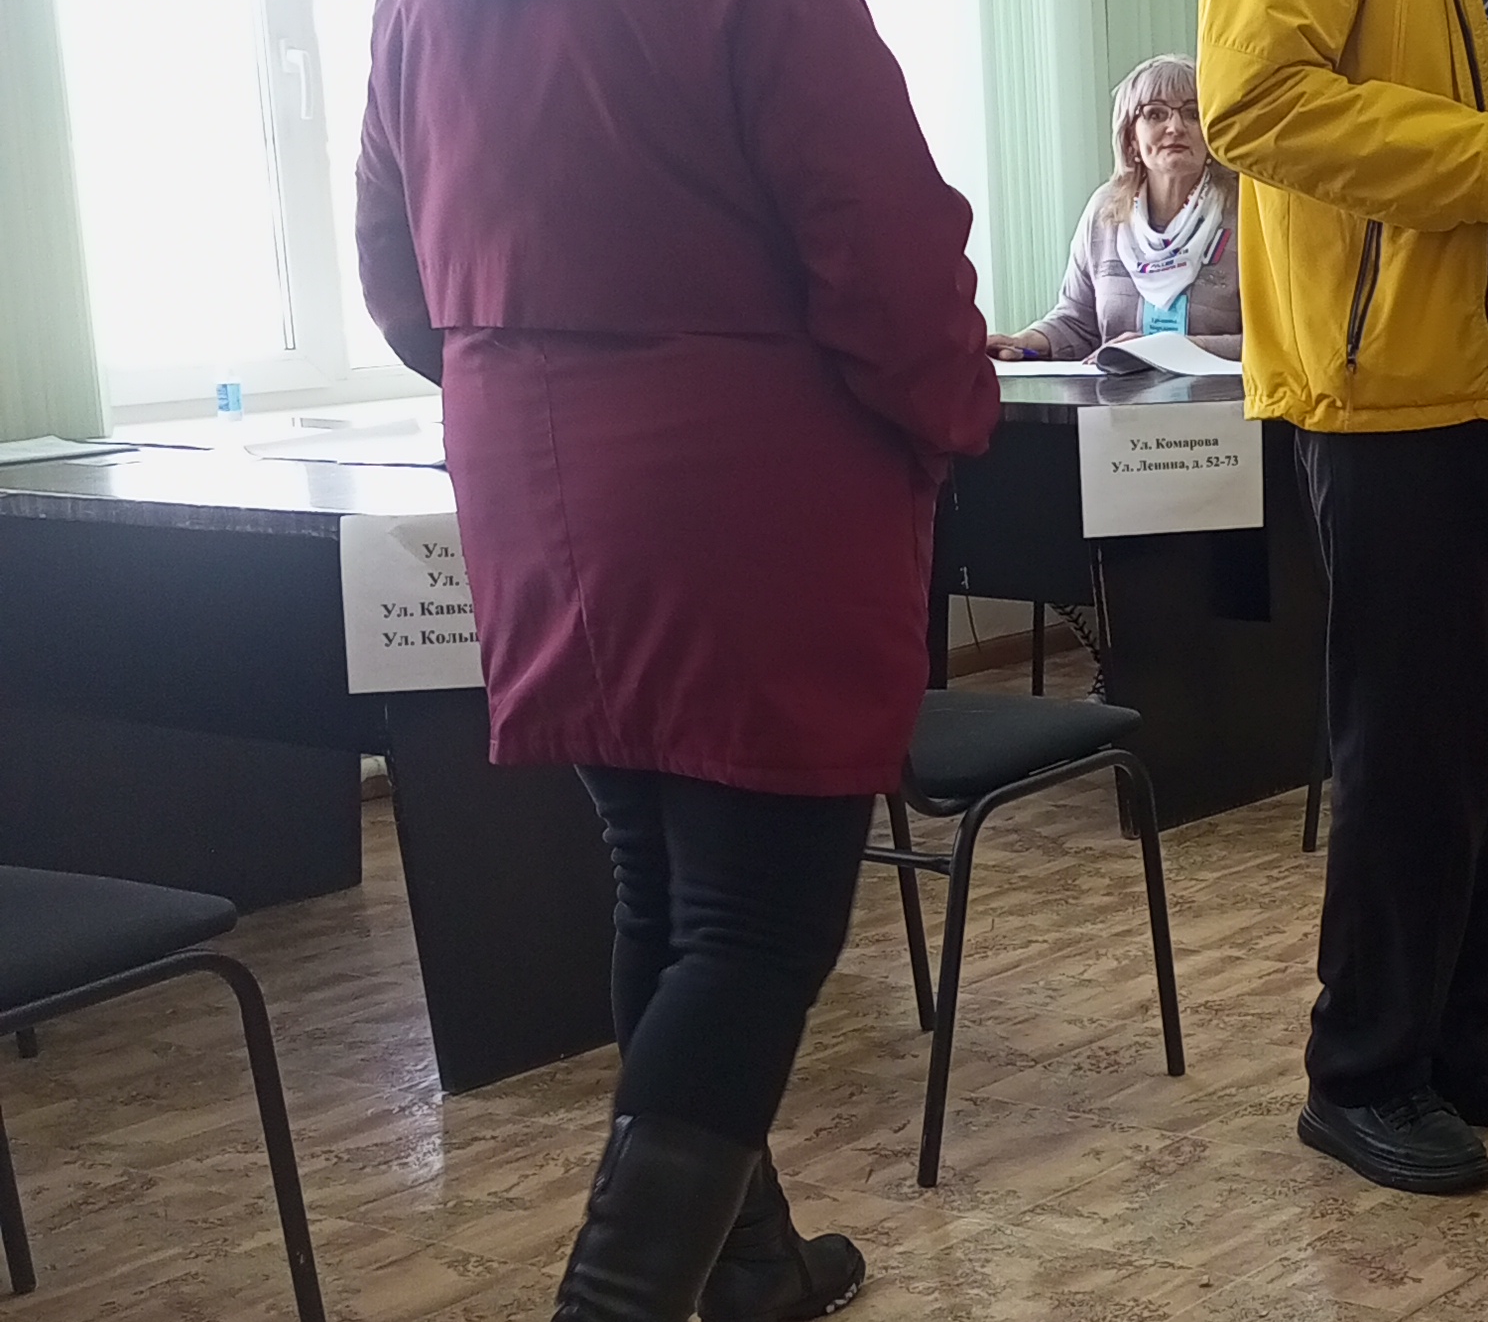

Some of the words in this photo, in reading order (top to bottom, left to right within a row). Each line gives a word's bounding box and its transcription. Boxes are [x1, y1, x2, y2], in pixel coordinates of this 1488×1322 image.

[1130, 439, 1153, 451] Ул.
[1155, 437, 1219, 451] Комарова
[1111, 461, 1134, 473] Ул.
[1136, 460, 1190, 472] Ленина,
[1191, 458, 1203, 470] д.
[1205, 455, 1239, 467] 52-73
[422, 543, 455, 559] Ул.
[427, 572, 460, 587] Ул.
[381, 603, 414, 619] Ул.
[382, 632, 415, 647] Ул.
